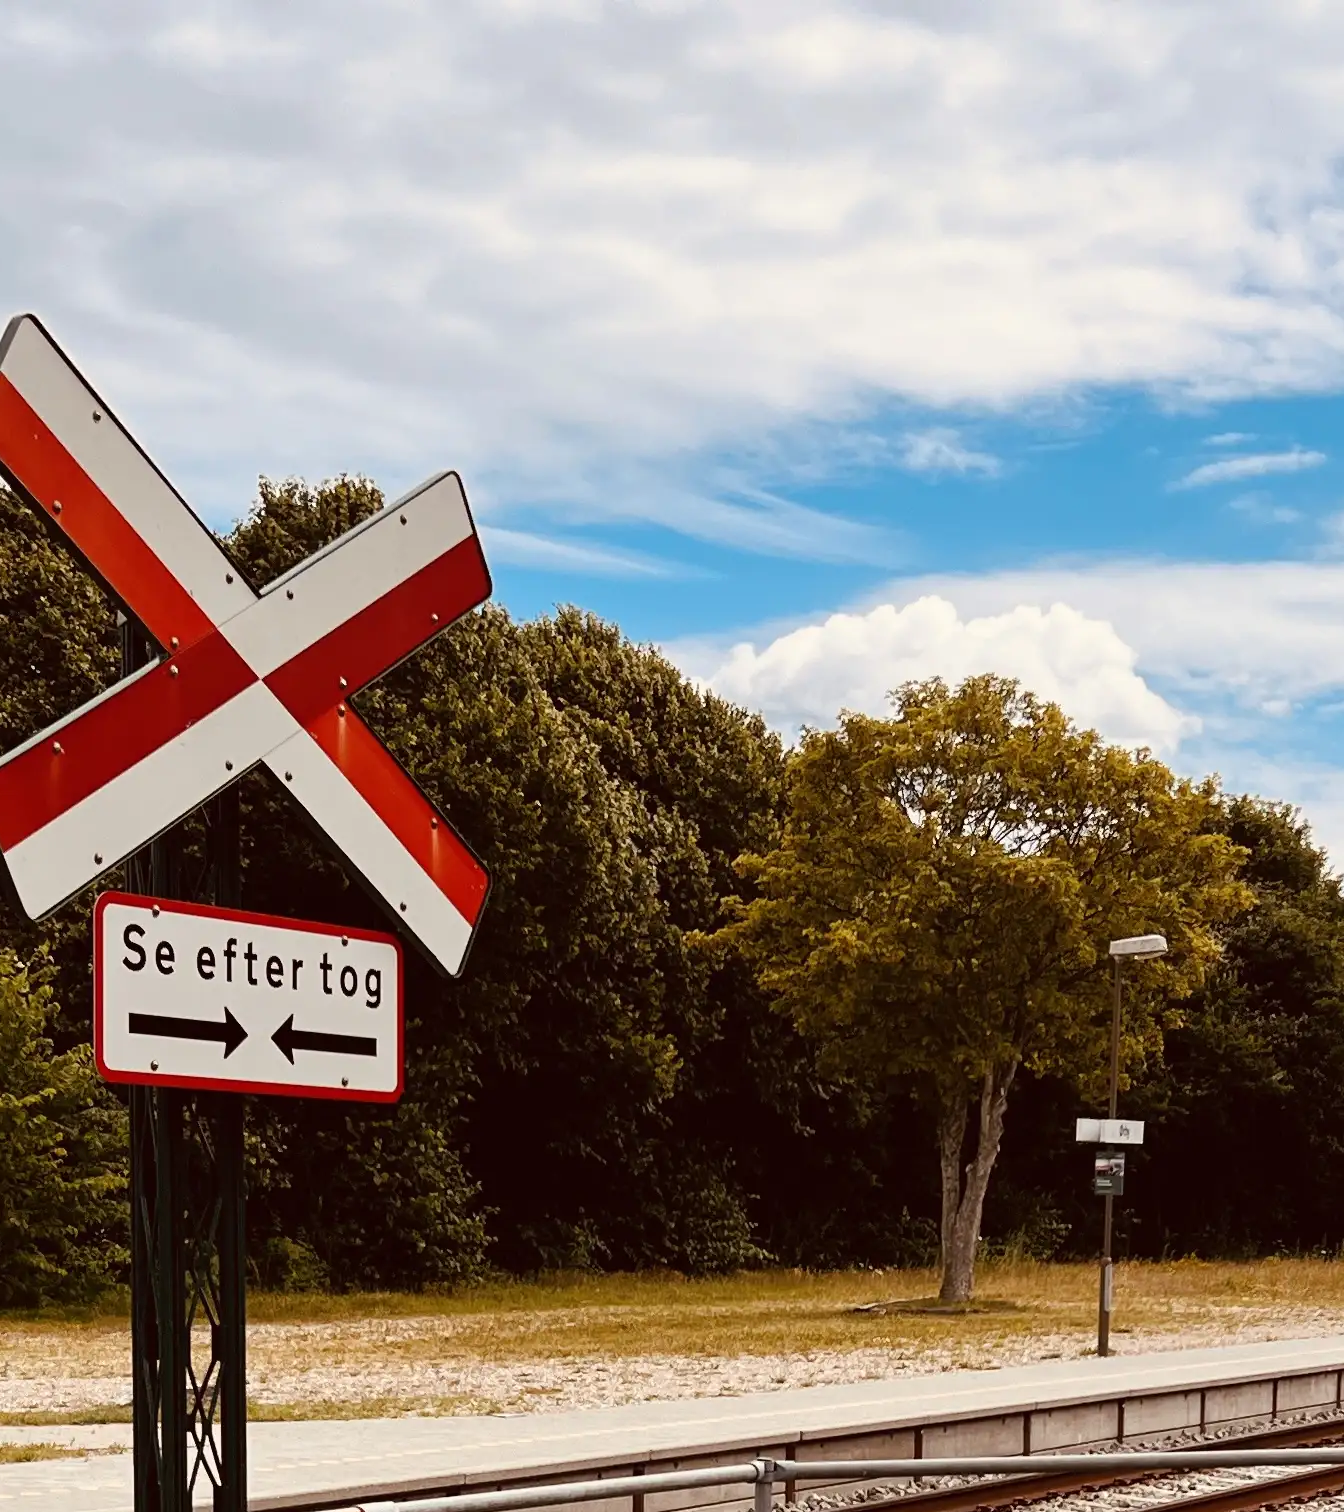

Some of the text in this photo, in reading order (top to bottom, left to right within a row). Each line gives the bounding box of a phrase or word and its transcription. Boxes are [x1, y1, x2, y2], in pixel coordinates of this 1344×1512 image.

[122, 923, 382, 1009] Se efter tog
